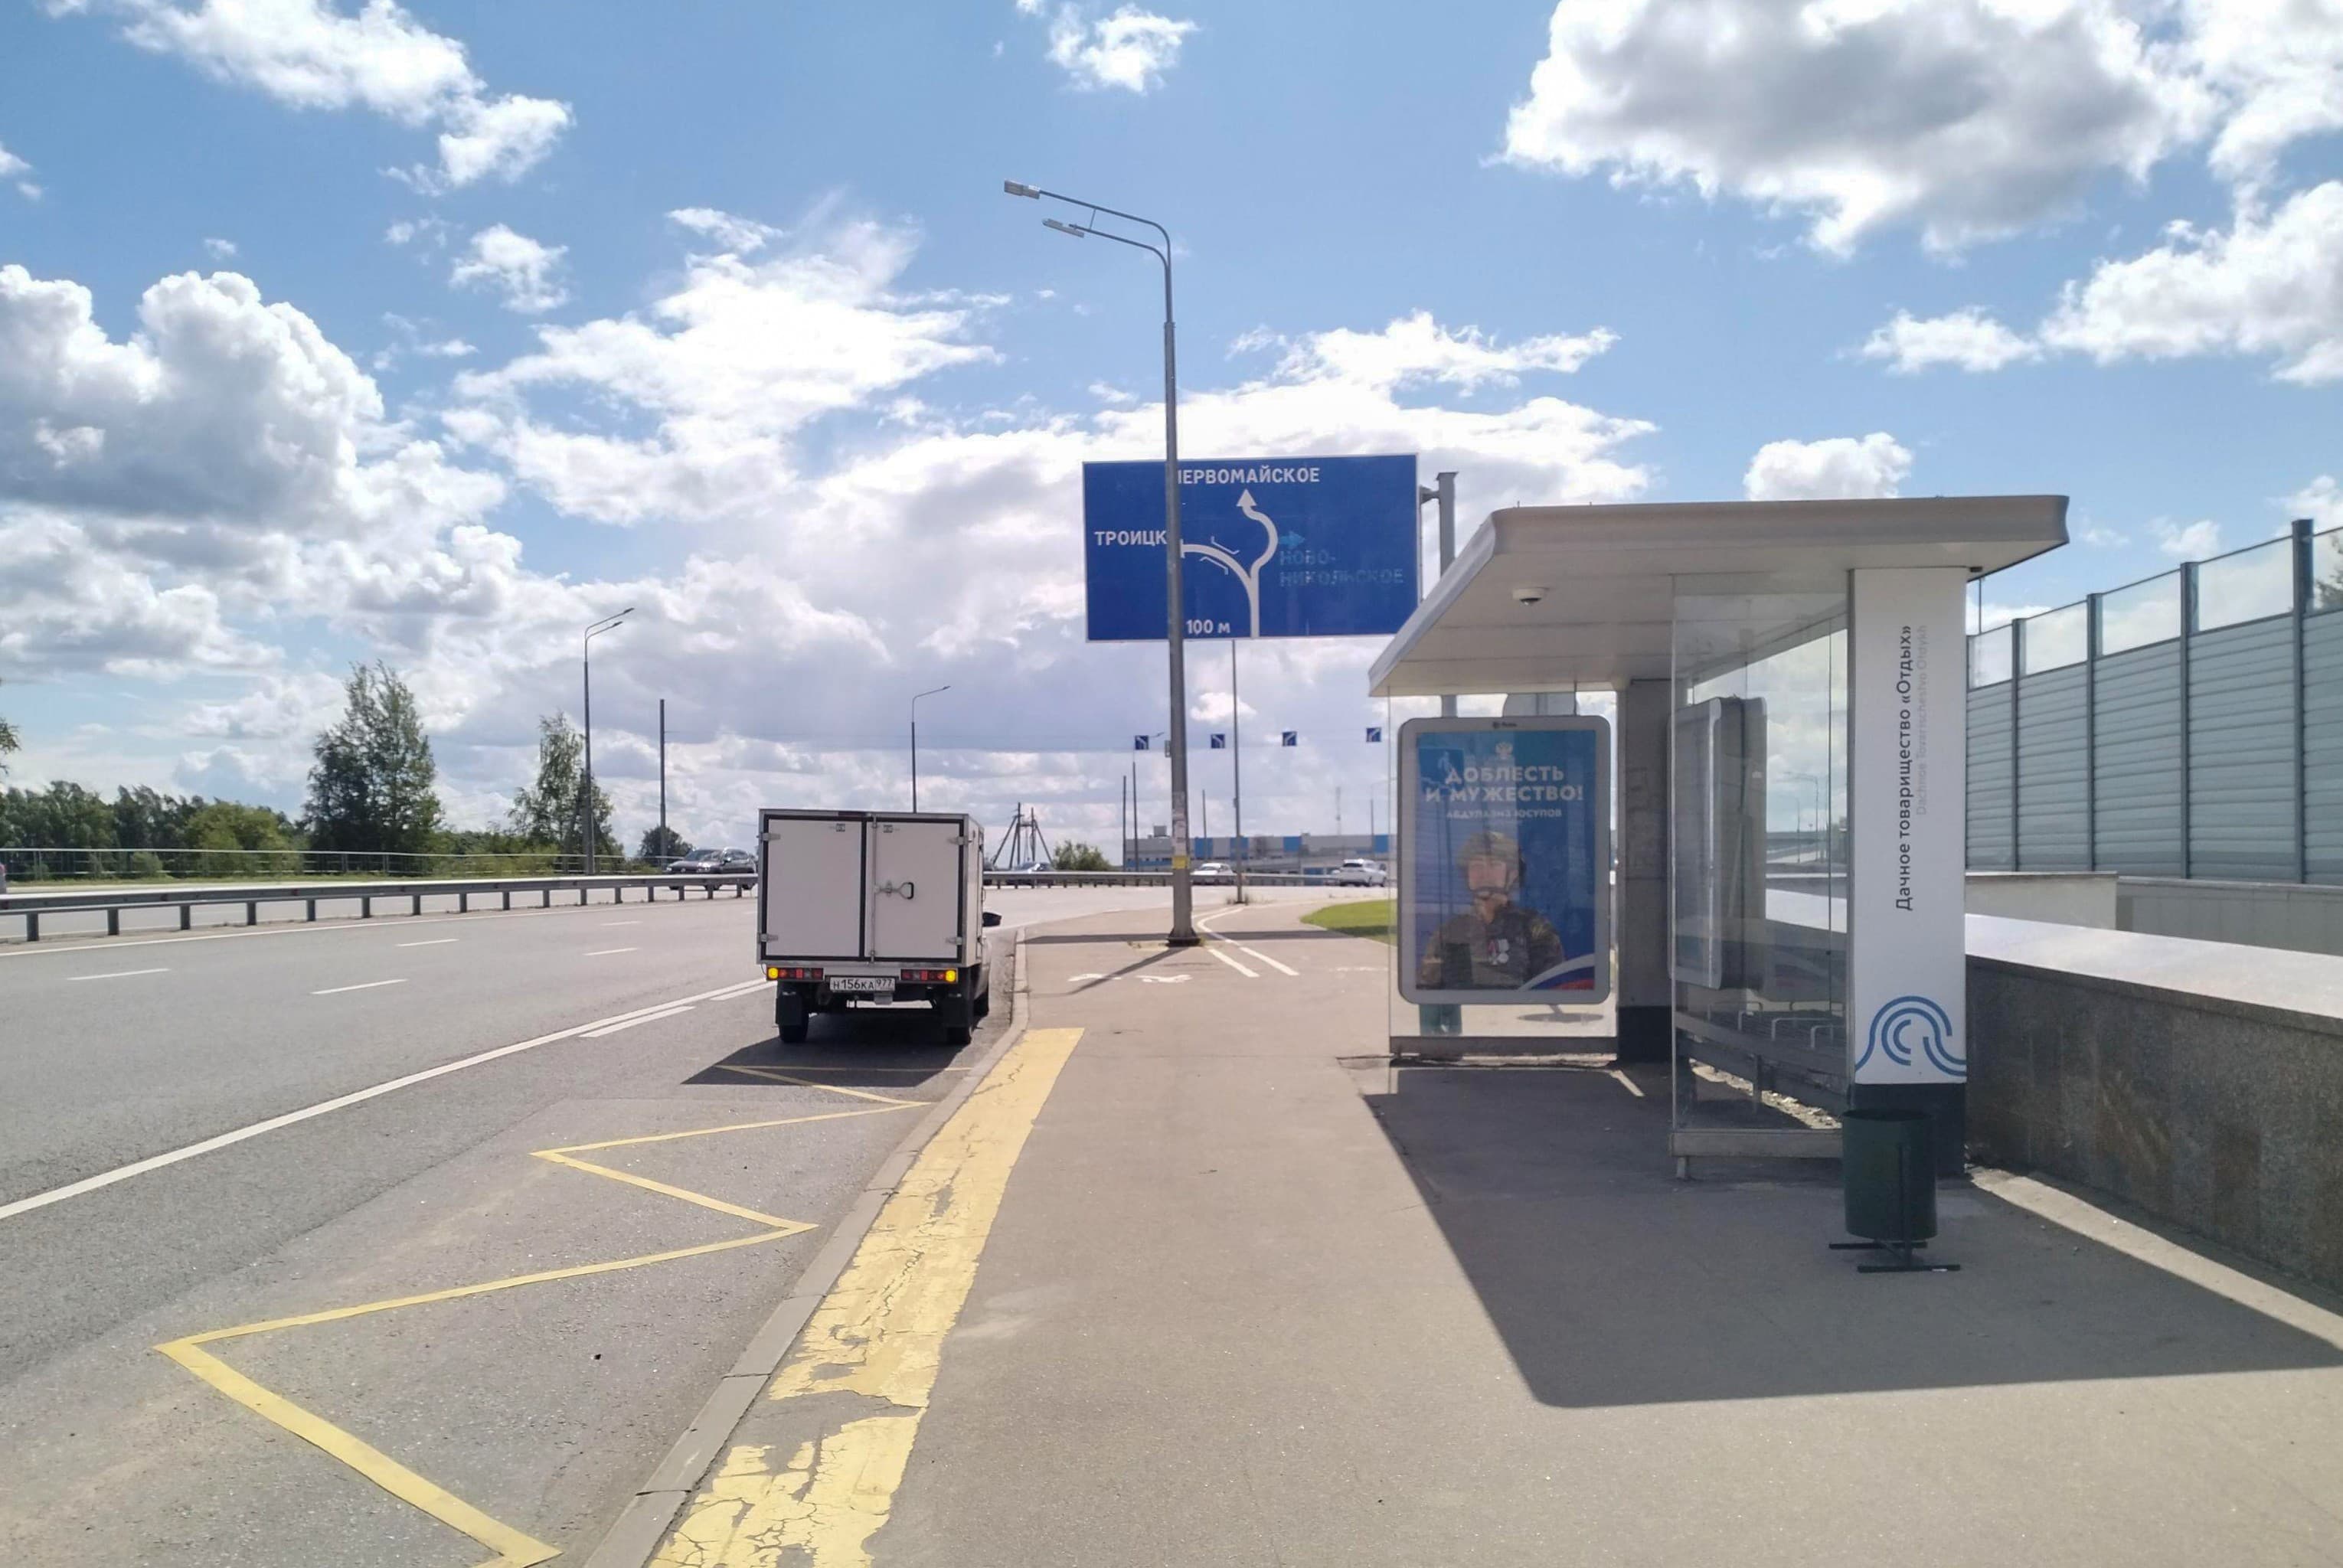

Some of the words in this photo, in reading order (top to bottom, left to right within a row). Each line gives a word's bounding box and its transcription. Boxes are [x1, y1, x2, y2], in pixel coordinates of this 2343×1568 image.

[1094, 530, 1167, 547] ТРОИЦК
[1186, 619, 1214, 634] 100
[1896, 626, 1913, 704] «Отдых»
[1445, 766, 1565, 784] ДОБЛЕСТЬ
[1898, 709, 1913, 838] товарищество
[1425, 787, 1440, 802] И
[1449, 785, 1584, 802] МУЖЕСТВО!
[1916, 763, 1927, 815] Dachnoe
[1896, 844, 1913, 911] Дачное
[876, 978, 892, 987] 977
